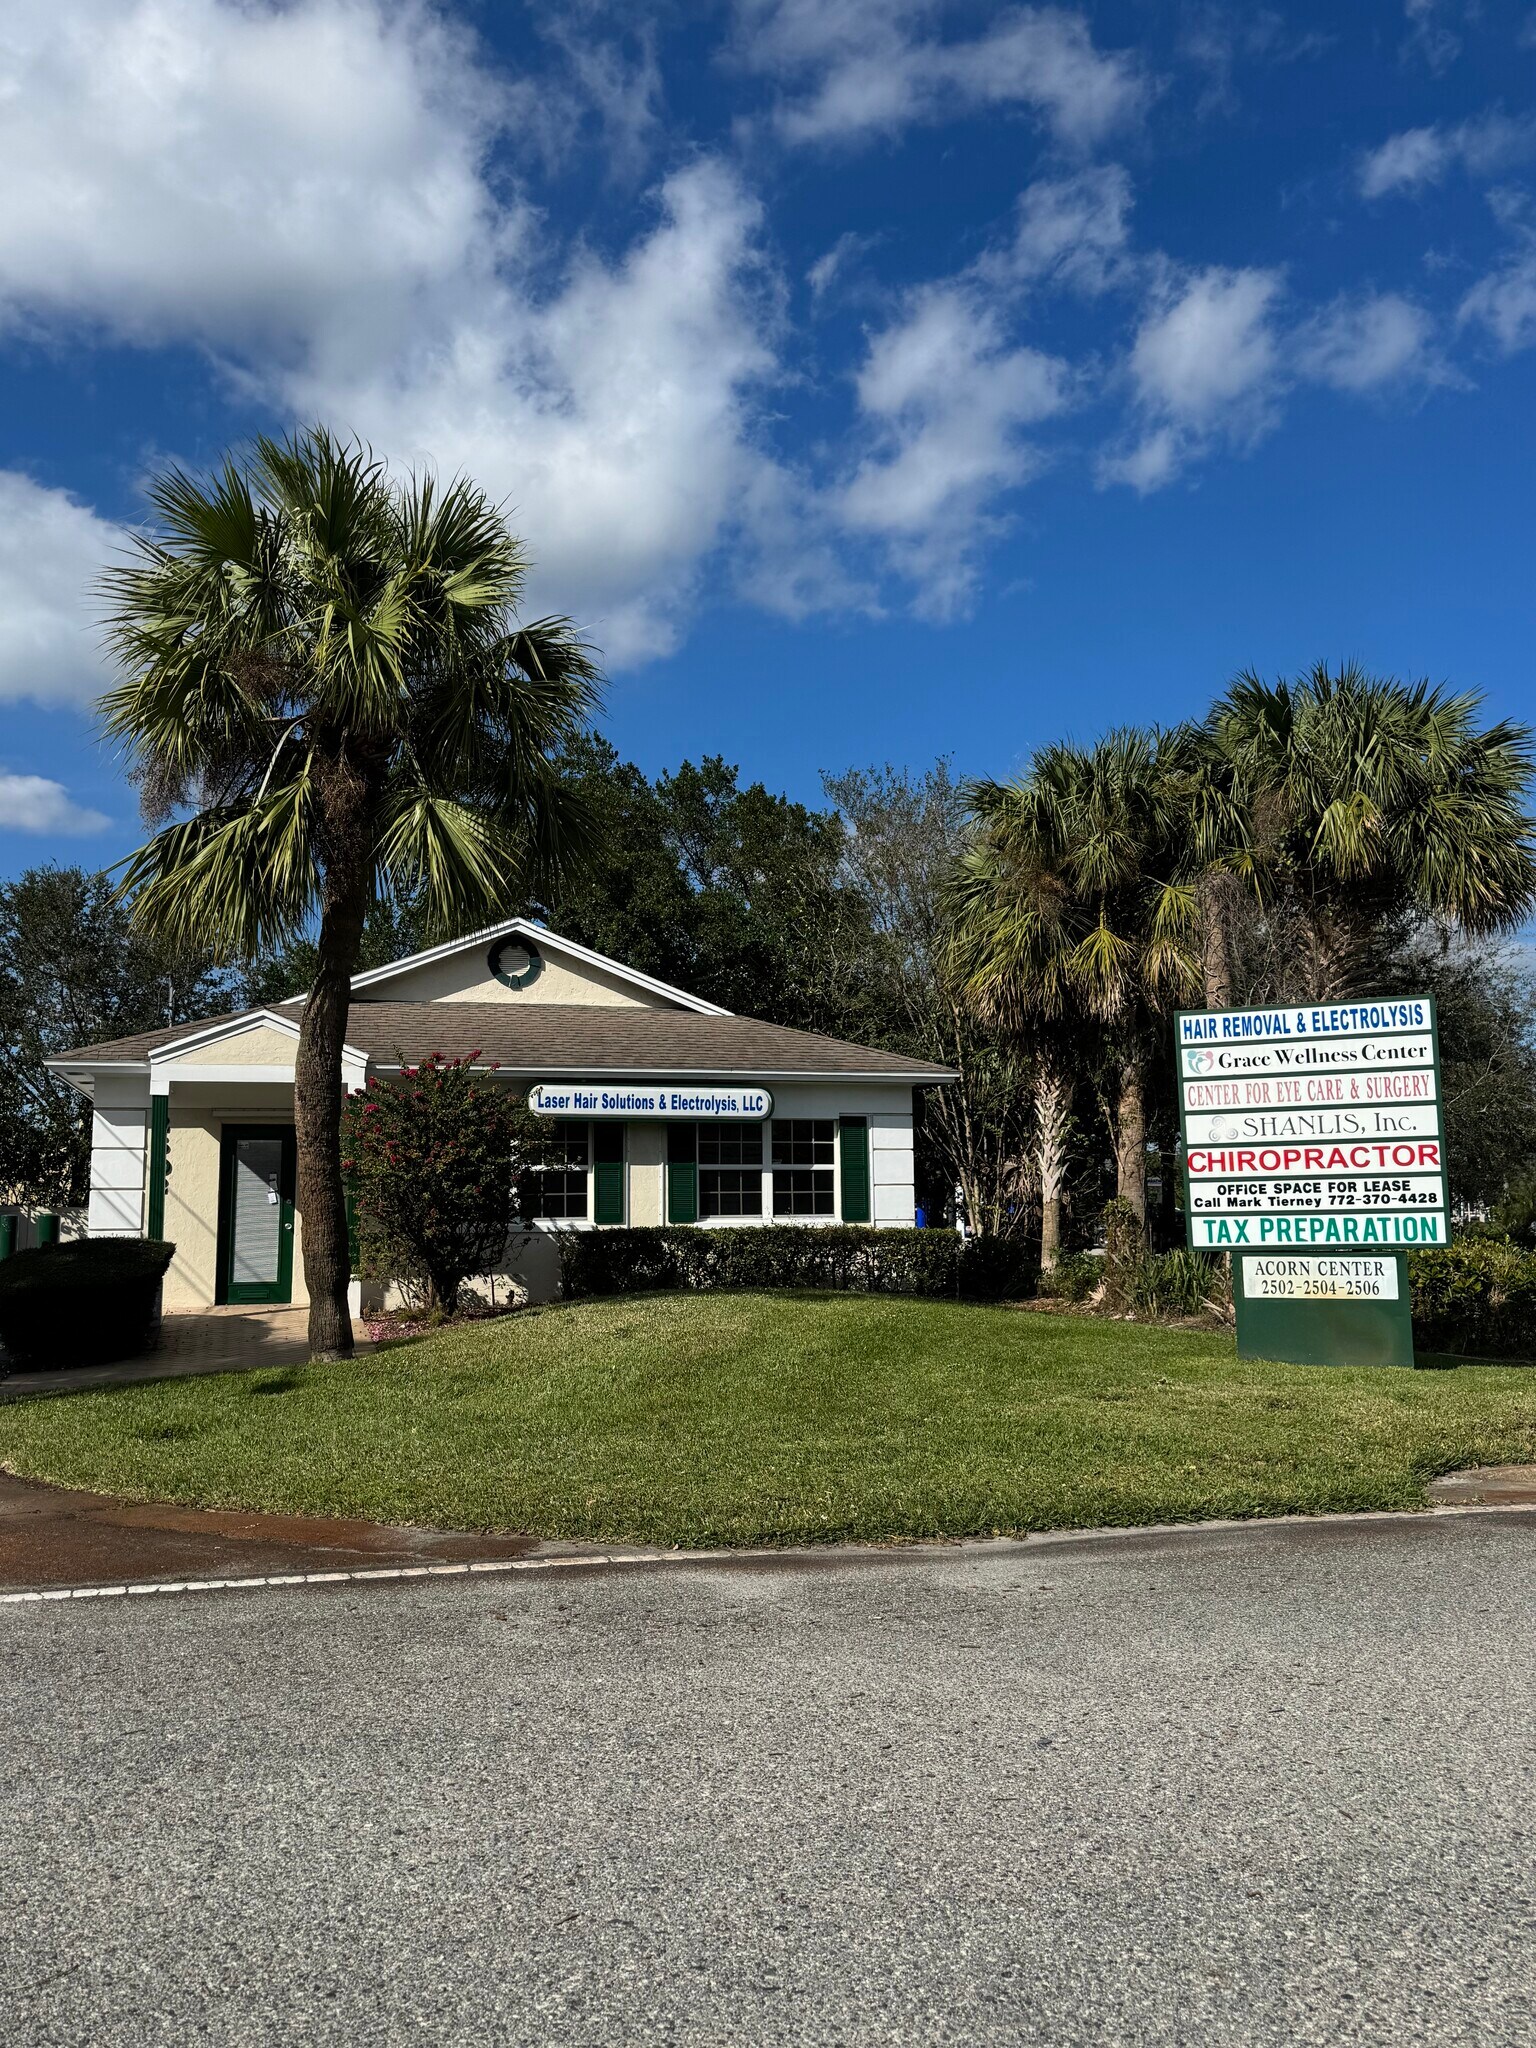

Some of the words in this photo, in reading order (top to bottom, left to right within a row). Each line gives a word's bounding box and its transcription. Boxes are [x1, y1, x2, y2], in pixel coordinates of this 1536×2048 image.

[1183, 1016, 1218, 1039] HAIR
[1223, 1013, 1290, 1037] REMOVAL
[1297, 1012, 1307, 1033] &
[1312, 1003, 1424, 1032] ELECTROLYSIS
[1218, 1052, 1271, 1069] Grace
[1274, 1048, 1358, 1065] Wellness
[1361, 1044, 1427, 1061] Center
[538, 1091, 570, 1108] Laser
[574, 1092, 598, 1109] Hair
[602, 1093, 655, 1110] Solutions
[659, 1095, 667, 1110] &
[671, 1094, 739, 1115] Electrolysis,
[742, 1096, 763, 1112] LLC
[1188, 1084, 1241, 1107] CENTER
[1246, 1082, 1272, 1104] FOR
[1277, 1080, 1301, 1103] EYE
[1307, 1078, 1343, 1101] CARE
[1350, 1078, 1360, 1099] &
[1366, 1074, 1430, 1099] SURGERY
[1243, 1113, 1366, 1137] SHANLIS,
[1374, 1112, 1417, 1132] Inc.
[1187, 1144, 1440, 1173] CHIROPRACTOR
[1217, 1184, 1267, 1196] OFFICE
[1274, 1182, 1322, 1194] SPACE
[1328, 1181, 1357, 1193] FOR
[1364, 1180, 1411, 1192] LEASE
[1194, 1197, 1220, 1208] Call
[1227, 1196, 1262, 1207] Mark
[1268, 1195, 1321, 1209] Tierney
[1329, 1193, 1437, 1206] 772-370-4428
[1203, 1219, 1250, 1244] TAX
[1260, 1216, 1438, 1243] PREPARATION
[1255, 1260, 1310, 1276] ACORN
[1317, 1261, 1385, 1277] CENTER
[1262, 1280, 1380, 1296] 2502-2504-2506
